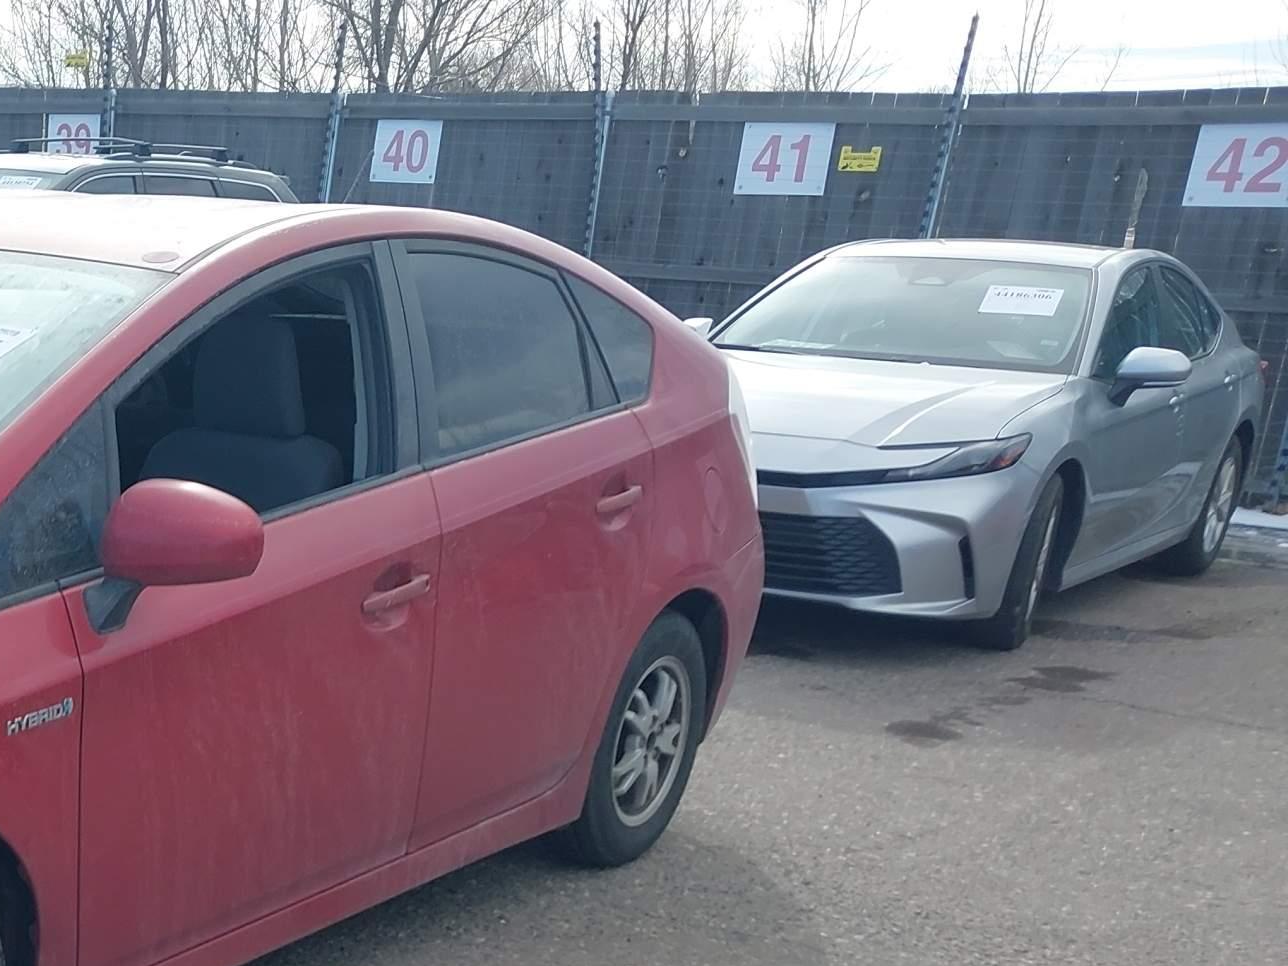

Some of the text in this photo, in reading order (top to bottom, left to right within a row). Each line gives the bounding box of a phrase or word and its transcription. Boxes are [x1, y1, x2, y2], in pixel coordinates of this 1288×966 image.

[56, 123, 91, 154] 39
[382, 129, 429, 173] 40
[751, 134, 811, 183] 41
[1206, 136, 1288, 193] 42
[7, 703, 63, 736] HYBRID
